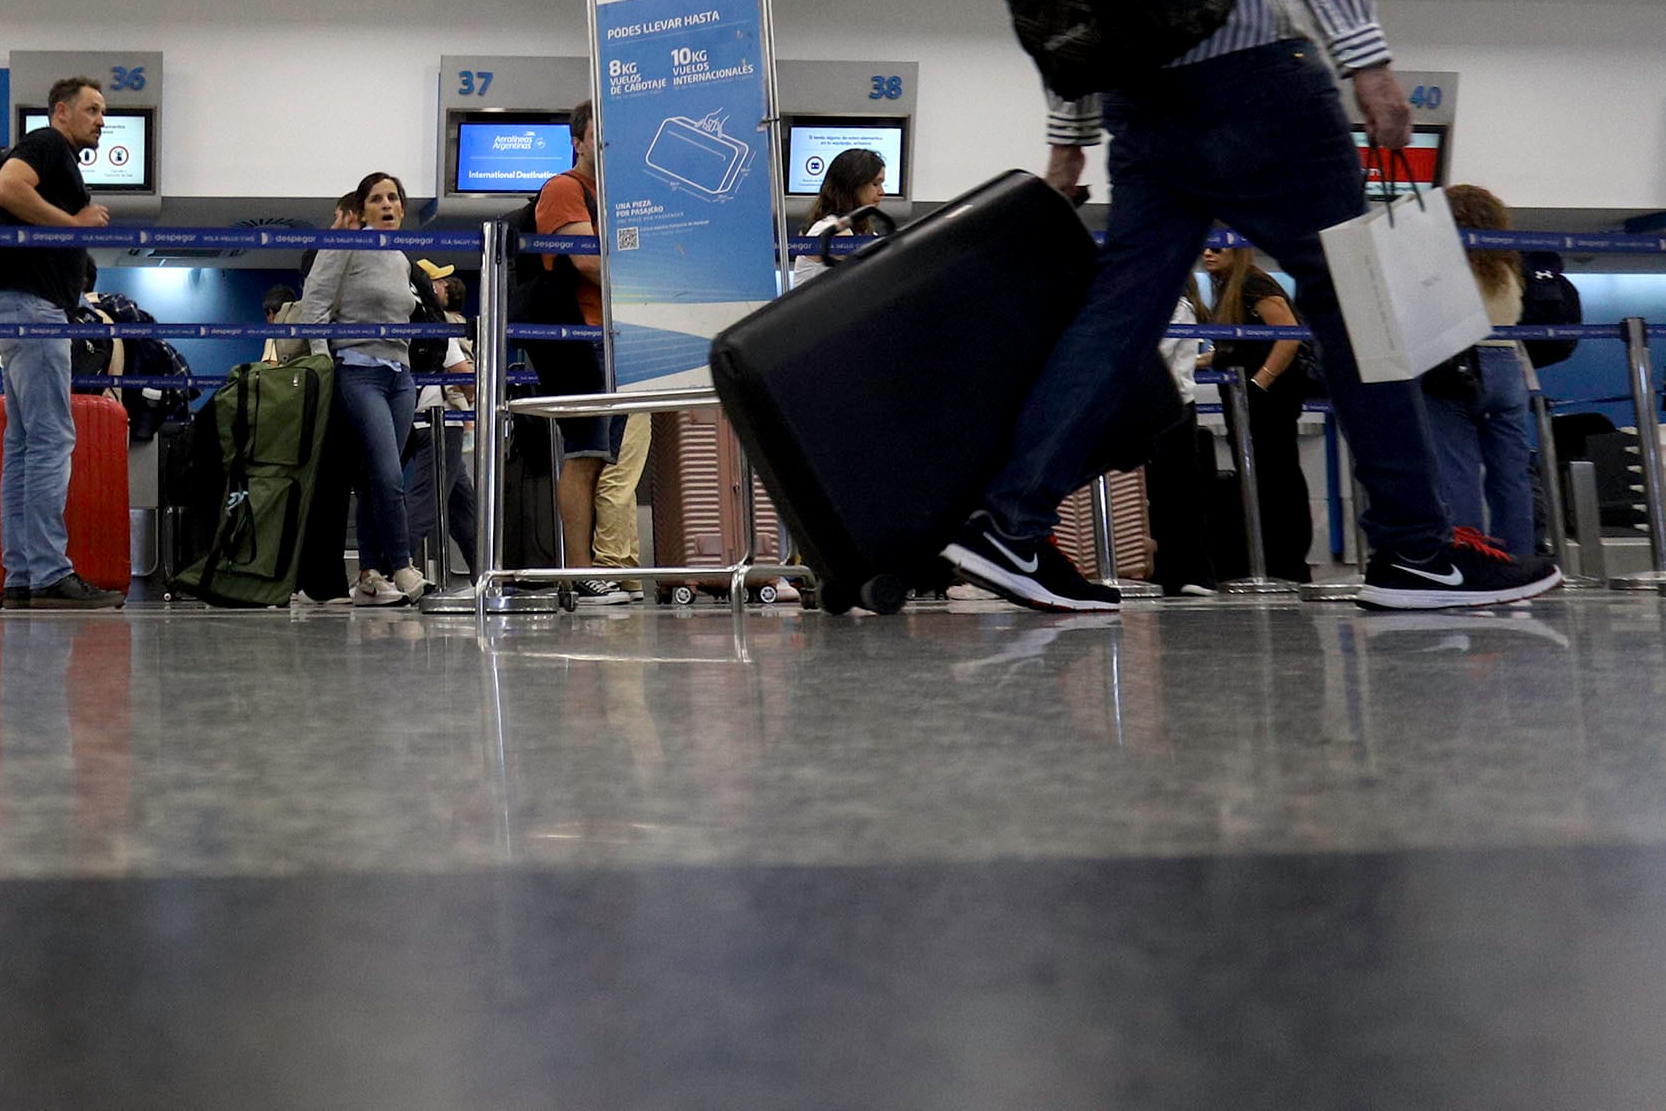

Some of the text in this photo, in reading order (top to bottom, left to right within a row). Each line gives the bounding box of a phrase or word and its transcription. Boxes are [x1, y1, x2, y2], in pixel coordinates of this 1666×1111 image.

[643, 17, 682, 34] LLEVAR
[684, 10, 720, 27] HASTA
[672, 62, 710, 76] VUELOS
[673, 64, 754, 86] INTERNACIONALES
[110, 65, 146, 91] 36
[458, 70, 494, 96] 37
[610, 74, 642, 86] VUELOS
[610, 85, 621, 95] DE
[624, 78, 667, 93] CABOTAJE
[869, 75, 903, 100] 38
[1408, 85, 1442, 109] 40
[468, 170, 515, 179] International
[615, 199, 652, 211] UNA PIEZA
[616, 205, 665, 218] POR PASAJERO
[31, 232, 75, 242] despegar
[154, 233, 196, 243] despegar
[275, 235, 317, 244] despegar
[393, 236, 434, 246] despegar
[533, 239, 575, 250] despegar
[120, 327, 153, 335] despegar
[210, 327, 243, 335] despegar
[391, 327, 423, 335] despegar
